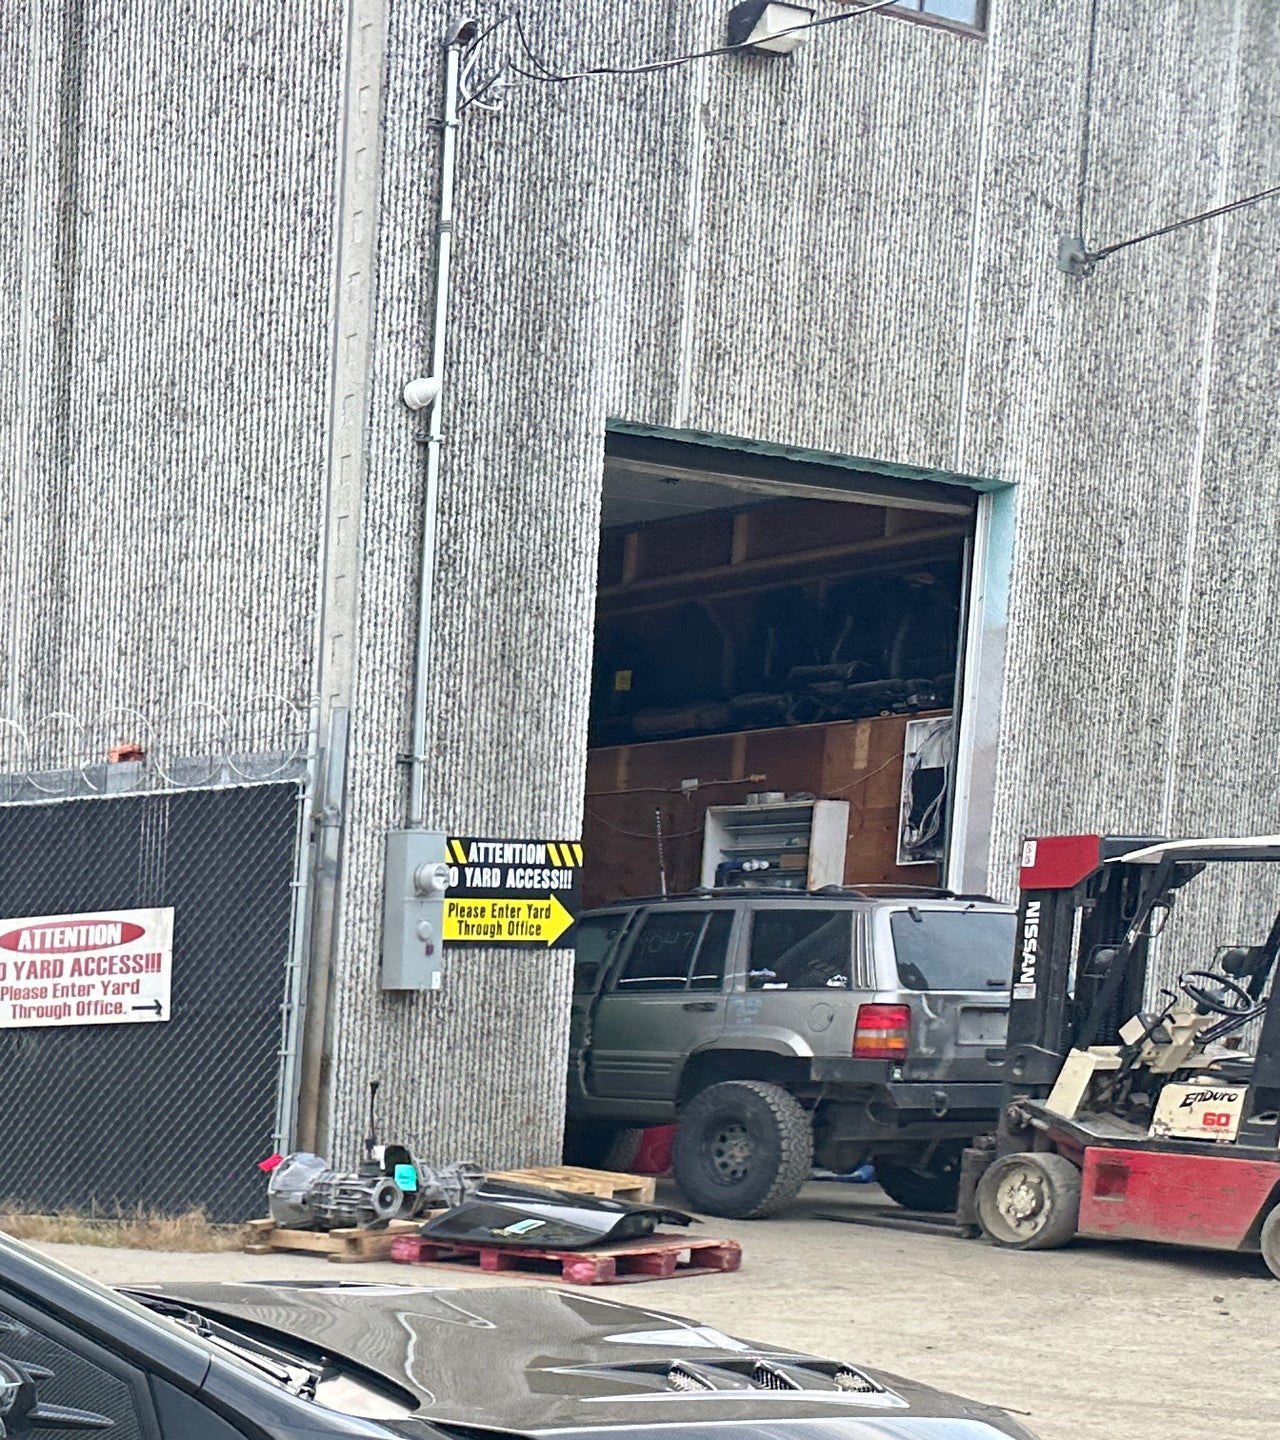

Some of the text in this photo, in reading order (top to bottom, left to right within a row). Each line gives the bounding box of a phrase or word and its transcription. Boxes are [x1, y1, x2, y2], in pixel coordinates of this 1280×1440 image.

[468, 842, 546, 865] ATTENTION
[464, 867, 501, 888] YARD
[506, 868, 573, 890] ACCESS!!!
[448, 902, 551, 919] Please Enter Yard
[18, 923, 122, 950] ATTENTION
[457, 920, 541, 938] Through Office
[1020, 901, 1041, 983] NISSAN
[13, 958, 64, 981] YARD
[70, 952, 162, 978] ACCESS!!!
[0, 979, 140, 1001] Please Enter Yard
[11, 1001, 71, 1020] Through
[1202, 1112, 1231, 1127] 60
